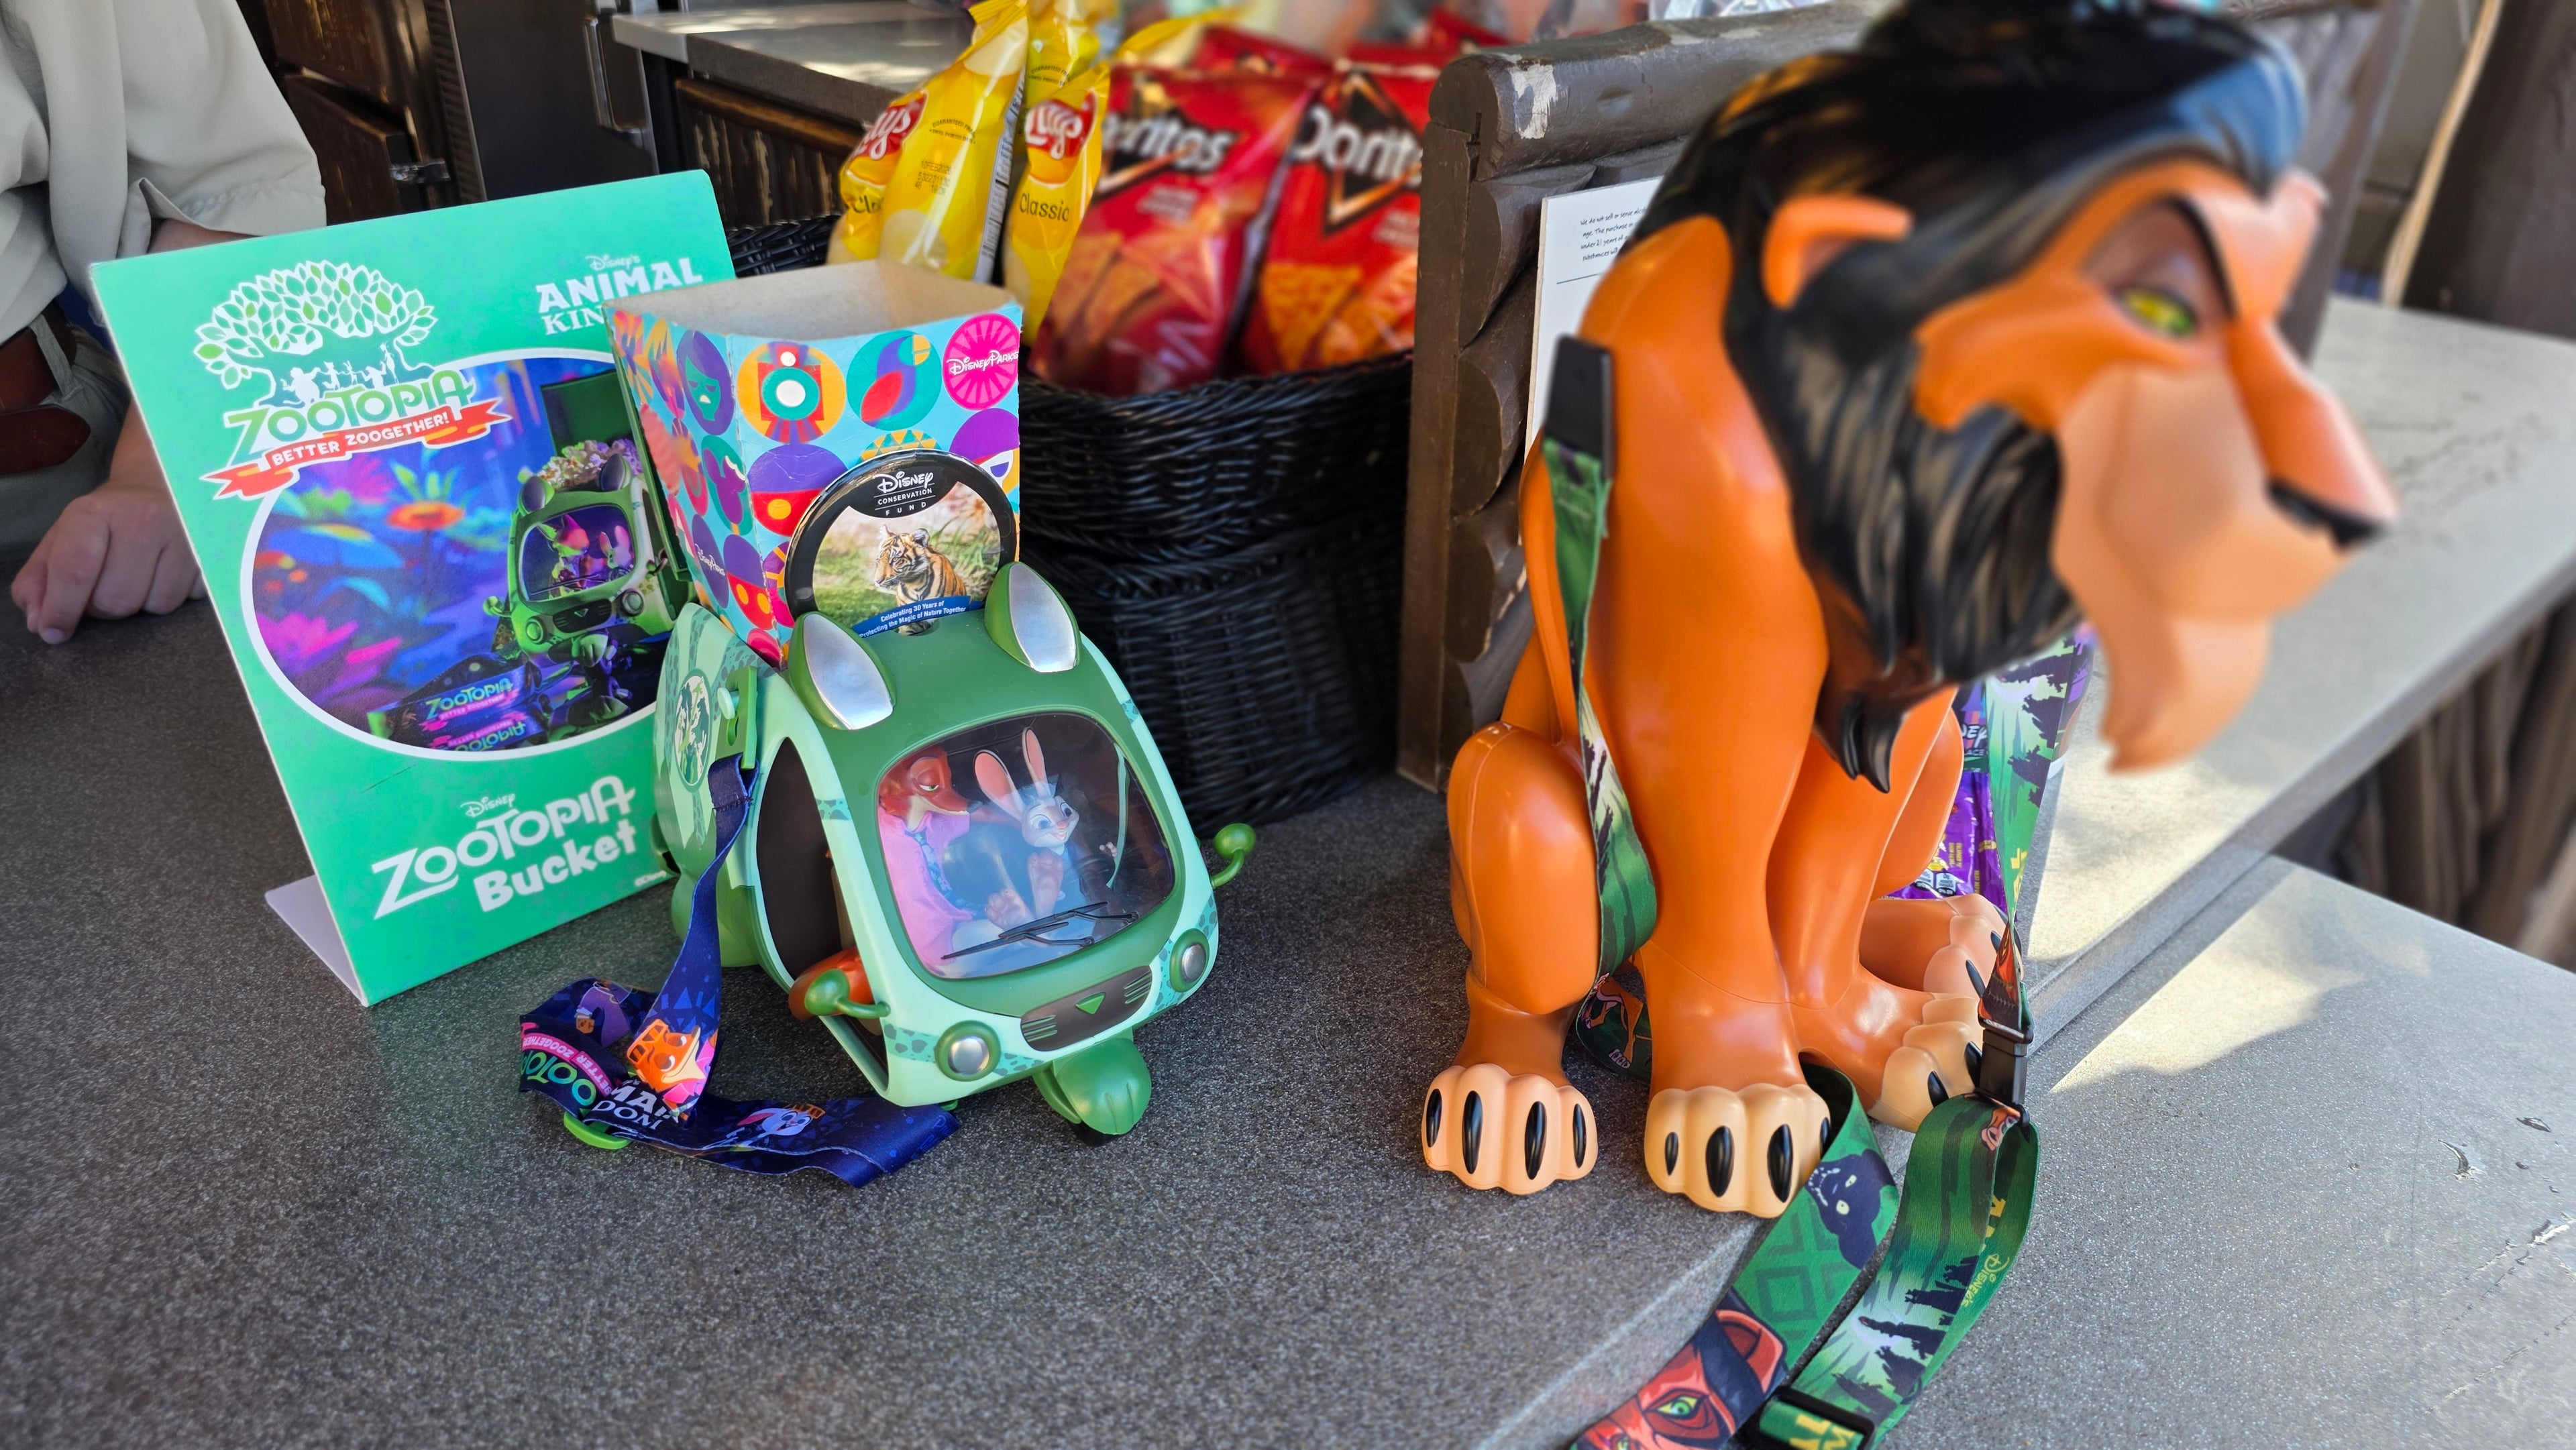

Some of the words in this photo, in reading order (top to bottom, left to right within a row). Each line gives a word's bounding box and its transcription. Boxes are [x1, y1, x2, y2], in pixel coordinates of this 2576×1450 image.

[1102, 111, 1236, 171] oritos
[1294, 105, 1423, 186] Dorit
[1019, 193, 1069, 222] Classic
[1605, 213, 1613, 221] sell
[1603, 237, 1617, 247] years
[1605, 223, 1627, 233] purchase
[586, 254, 641, 271] Disney's
[1582, 250, 1610, 262] substances
[535, 257, 703, 313] ANIMAL
[224, 369, 476, 466] ZOOTOPIA
[272, 440, 341, 467] BETTER
[345, 411, 450, 446] ZOOGETHER!
[872, 471, 934, 494] Disney
[877, 488, 932, 506] CONSERVATION
[859, 624, 888, 638] Protecting
[899, 614, 916, 624] Magic
[923, 608, 942, 617] Nature
[943, 606, 967, 615] Together
[880, 607, 913, 622] Celebrating
[425, 678, 514, 720] ZOOTOPIA
[460, 793, 516, 818] Disney
[371, 775, 637, 920] ZOOTOPIA
[474, 819, 637, 912] Bucket
[576, 1054, 613, 1096] BETTER
